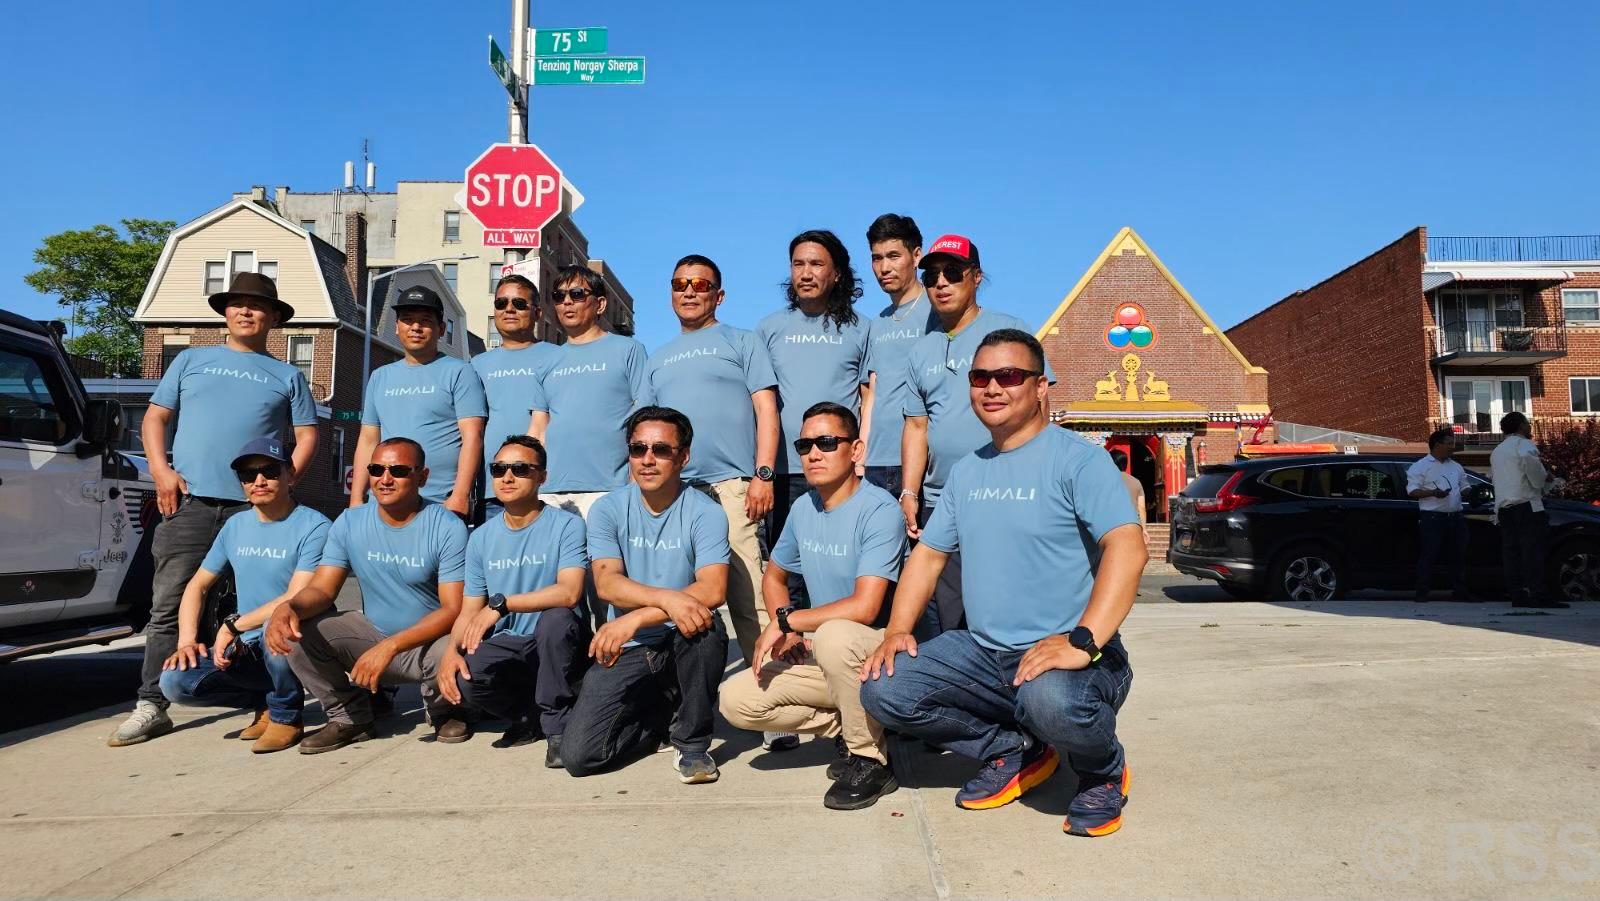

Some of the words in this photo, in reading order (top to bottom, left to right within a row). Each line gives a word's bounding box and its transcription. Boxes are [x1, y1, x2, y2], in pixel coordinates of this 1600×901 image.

[552, 32, 572, 52] 75
[577, 30, 587, 42] St
[538, 59, 571, 75] Tenzing
[574, 59, 605, 74] Norgay
[608, 59, 638, 74] Sherpa
[580, 73, 594, 82] Way
[471, 173, 556, 207] STOP
[487, 233, 509, 243] ALL
[513, 233, 536, 243] WAY
[784, 334, 842, 345] HIMALI
[875, 328, 919, 344] HIMALI
[663, 347, 717, 365] HIMALI
[487, 368, 535, 379] HIMAL
[552, 362, 607, 378] HIMALI
[926, 355, 973, 376] HIMA
[203, 367, 268, 384] HIMALI
[384, 385, 435, 397] HIMALI
[967, 487, 1036, 502] HIMALI
[628, 537, 681, 551] HIMALI
[802, 539, 848, 557] HIMALI
[103, 549, 129, 564] Jeep
[237, 547, 287, 559] HIMALI
[367, 551, 425, 568] HIMALI
[488, 553, 547, 570] HIMALI
